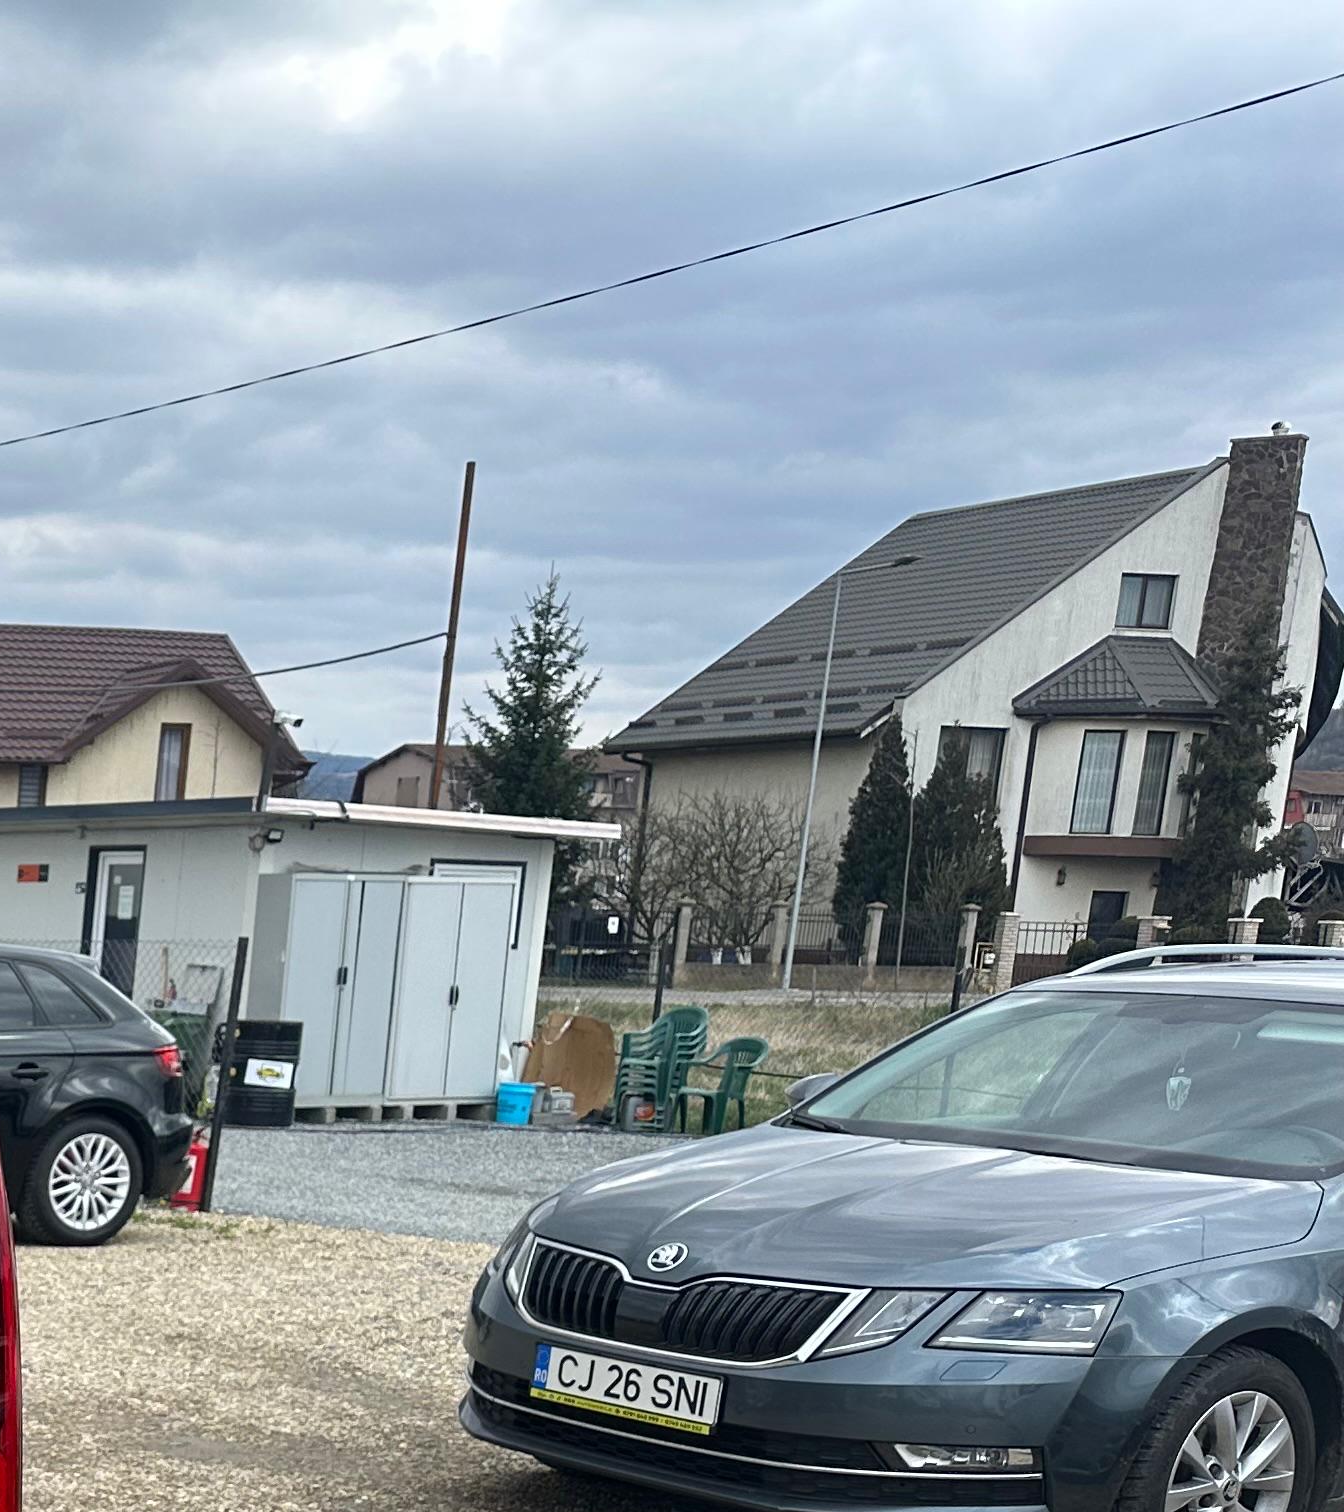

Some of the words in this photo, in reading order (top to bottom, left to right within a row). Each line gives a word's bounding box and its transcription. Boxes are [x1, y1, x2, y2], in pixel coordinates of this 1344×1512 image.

[534, 1367, 548, 1383] RO
[558, 1355, 595, 1392] CJ
[604, 1364, 643, 1401] 26
[651, 1374, 708, 1417] SNI
